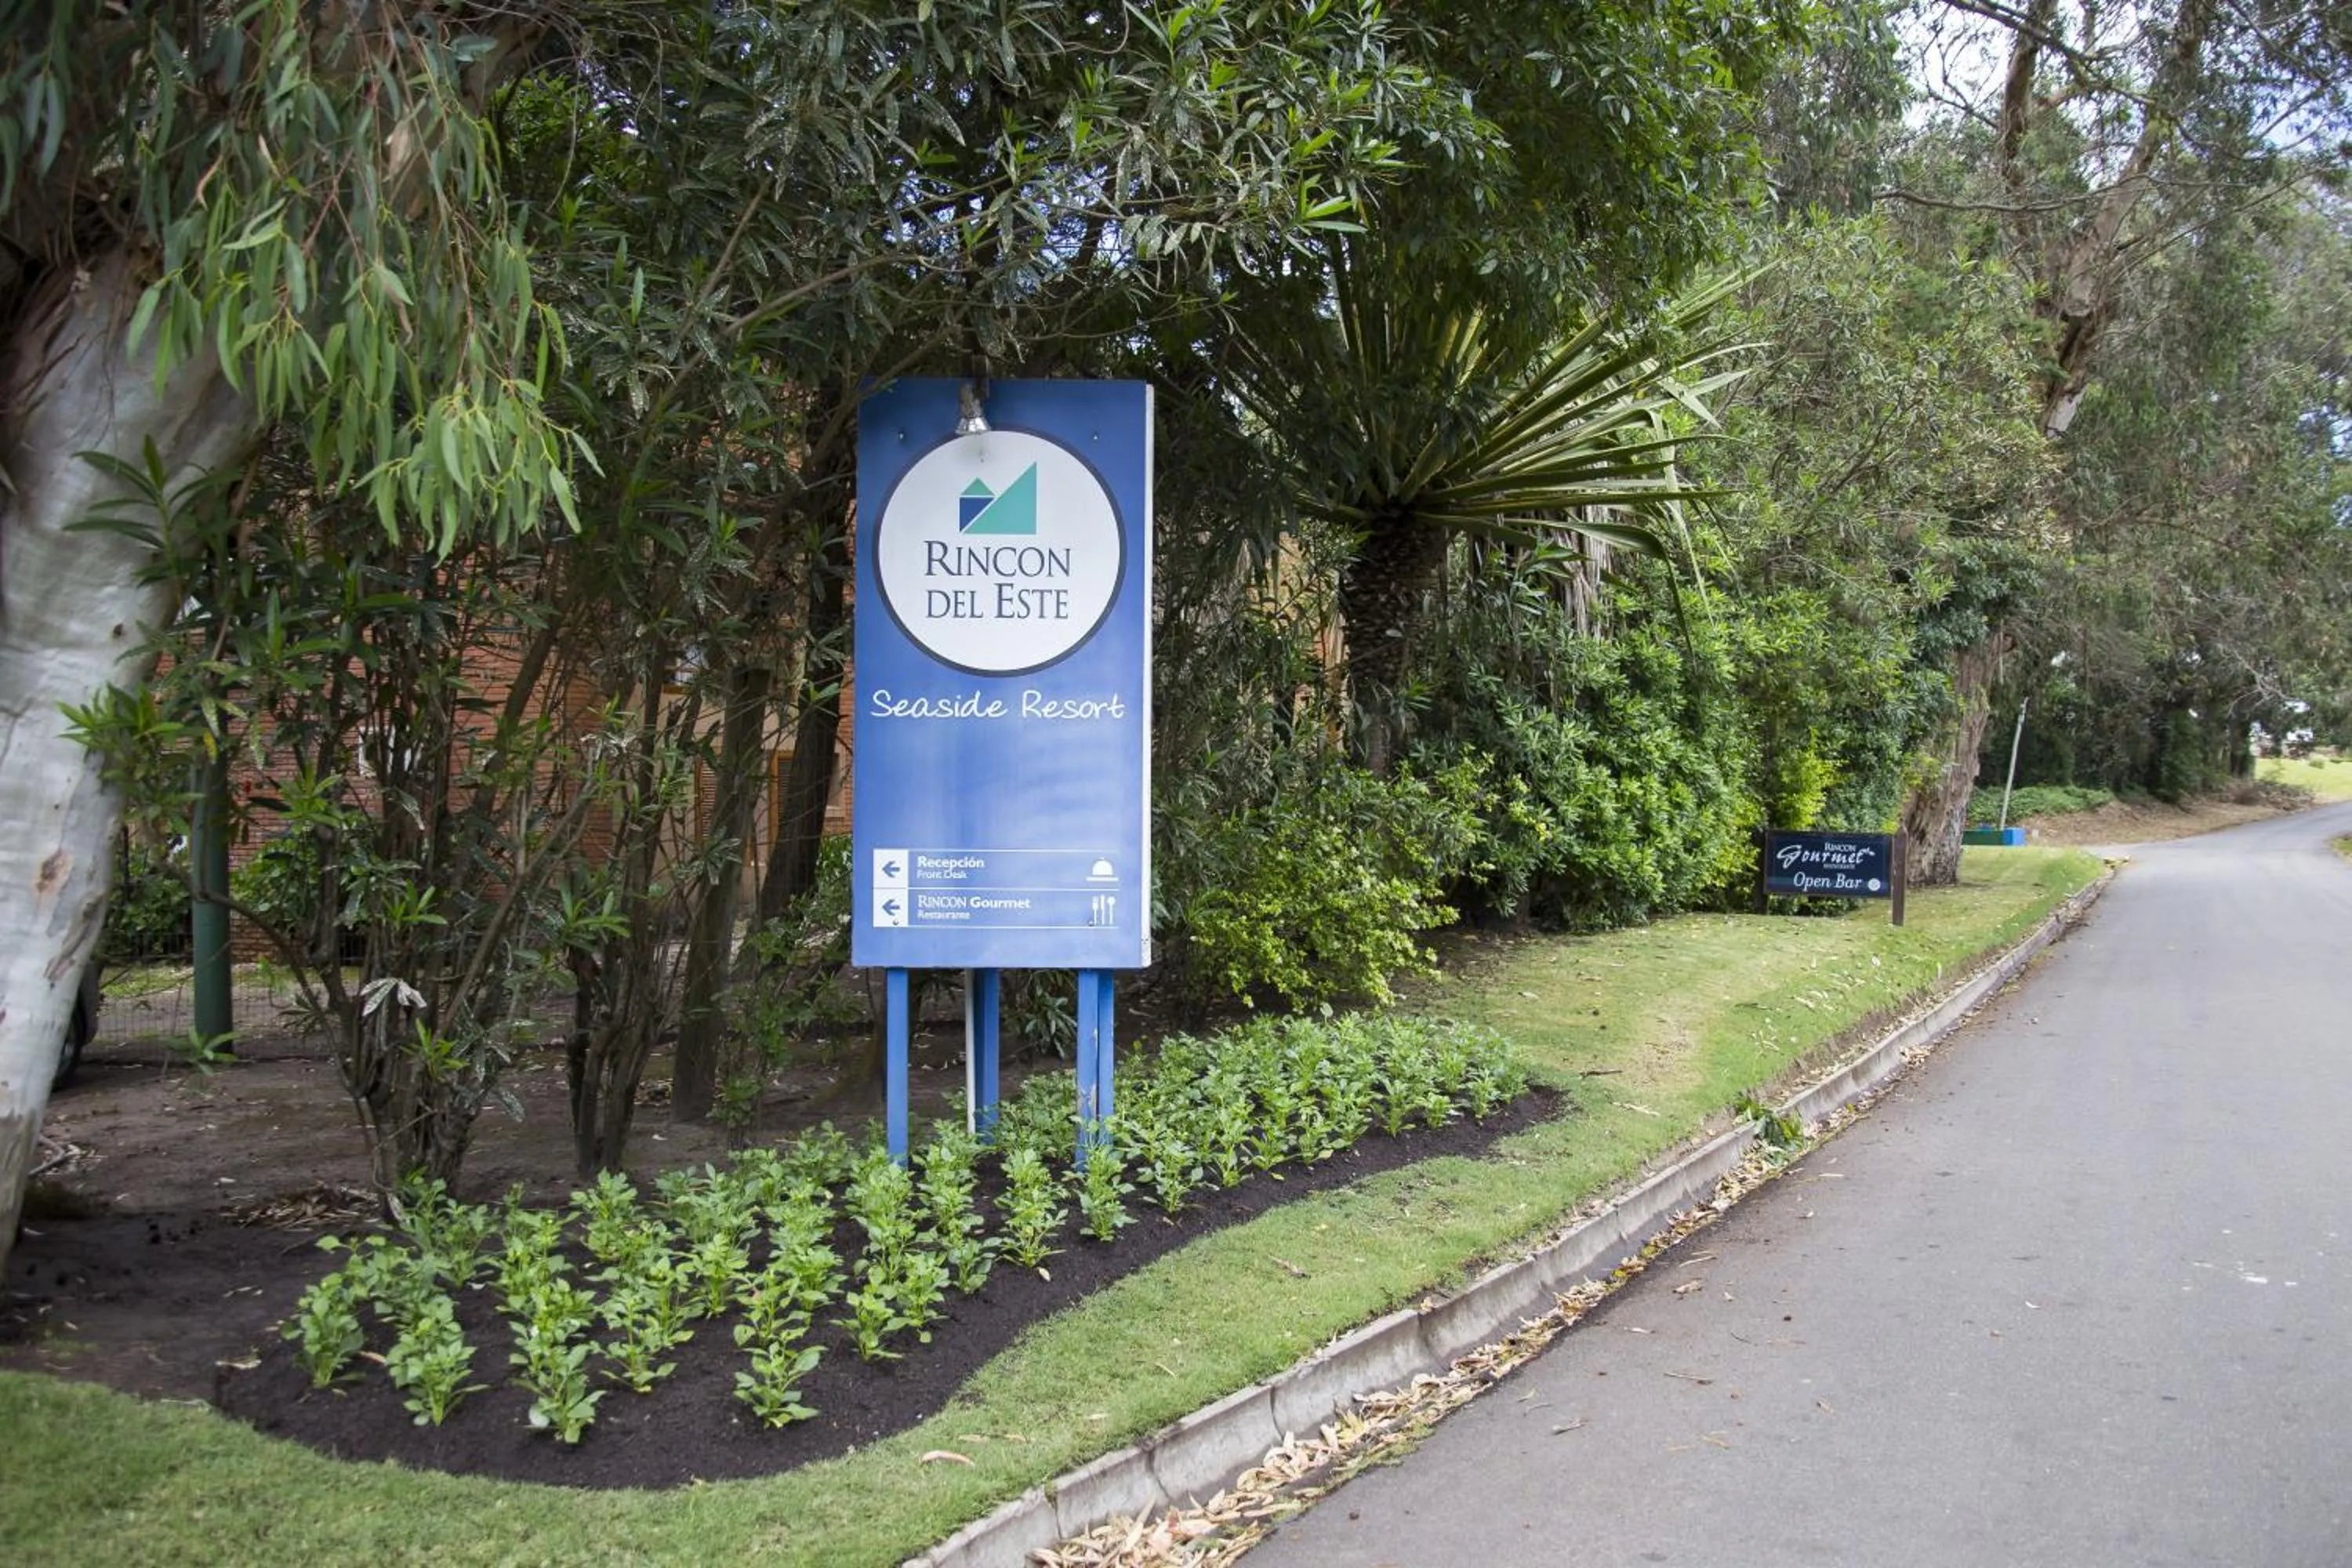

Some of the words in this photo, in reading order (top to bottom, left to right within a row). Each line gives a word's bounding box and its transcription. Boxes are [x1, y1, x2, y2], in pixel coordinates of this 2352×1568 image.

[924, 540, 1070, 578] RINCON
[927, 590, 984, 619] DEL
[994, 583, 1069, 619] ESTE
[871, 690, 1009, 718] Seaside
[1022, 690, 1125, 718] Resort
[917, 855, 985, 872] Recepción
[1777, 844, 1875, 869] Gourmet
[916, 869, 942, 879] Front
[1793, 871, 1831, 891] Open
[1834, 873, 1863, 889] Bar
[917, 895, 967, 908] RINCON
[970, 896, 1031, 909] Gourmet
